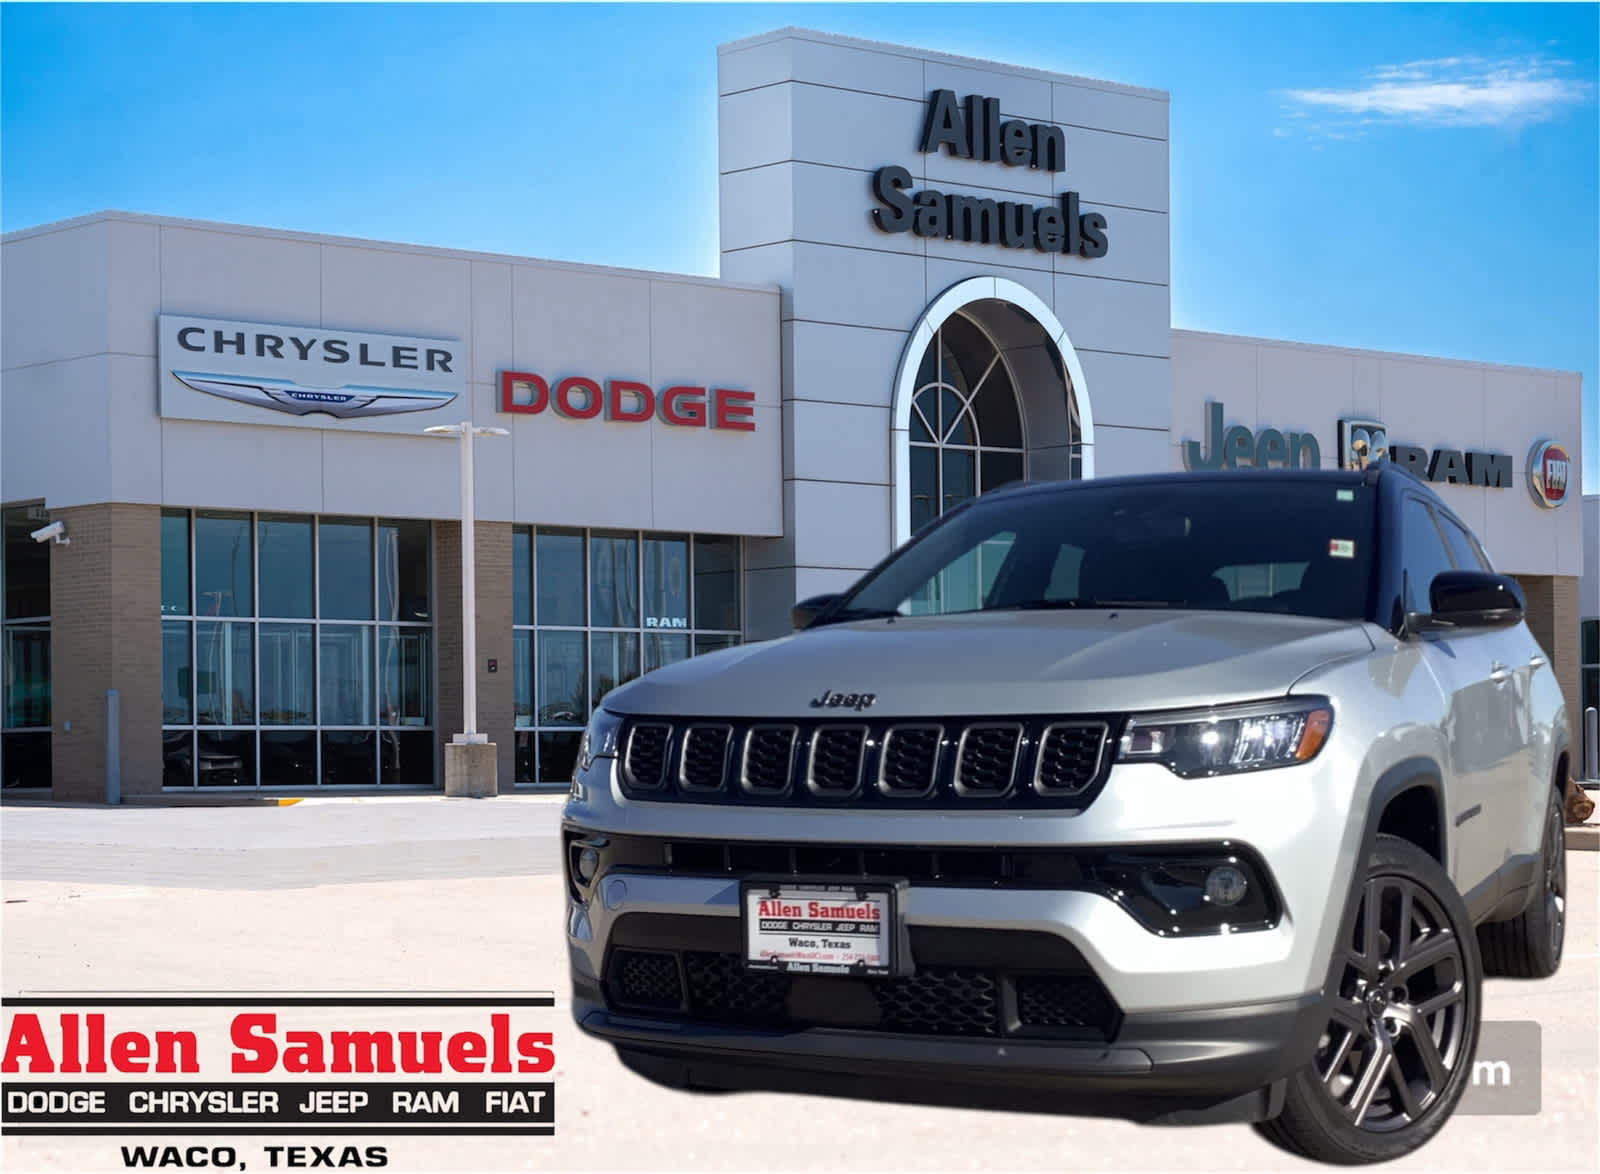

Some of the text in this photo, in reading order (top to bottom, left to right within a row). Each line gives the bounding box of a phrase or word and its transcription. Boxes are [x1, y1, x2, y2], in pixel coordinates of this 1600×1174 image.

[919, 88, 1066, 173] Allen
[872, 165, 1108, 258] Samuels
[177, 326, 454, 374] CHRYSLER
[291, 391, 347, 401] CHRYSLER
[496, 370, 756, 432] DODGE
[1390, 445, 1512, 488] RAM
[1546, 459, 1567, 489] FIAT
[646, 616, 687, 628] RAM
[809, 690, 877, 712] Jeep
[758, 900, 880, 920] Allen Samuels
[761, 921, 879, 933] DODGE CHRYSLER JEEP RAM
[789, 937, 852, 950] Waco, Texas
